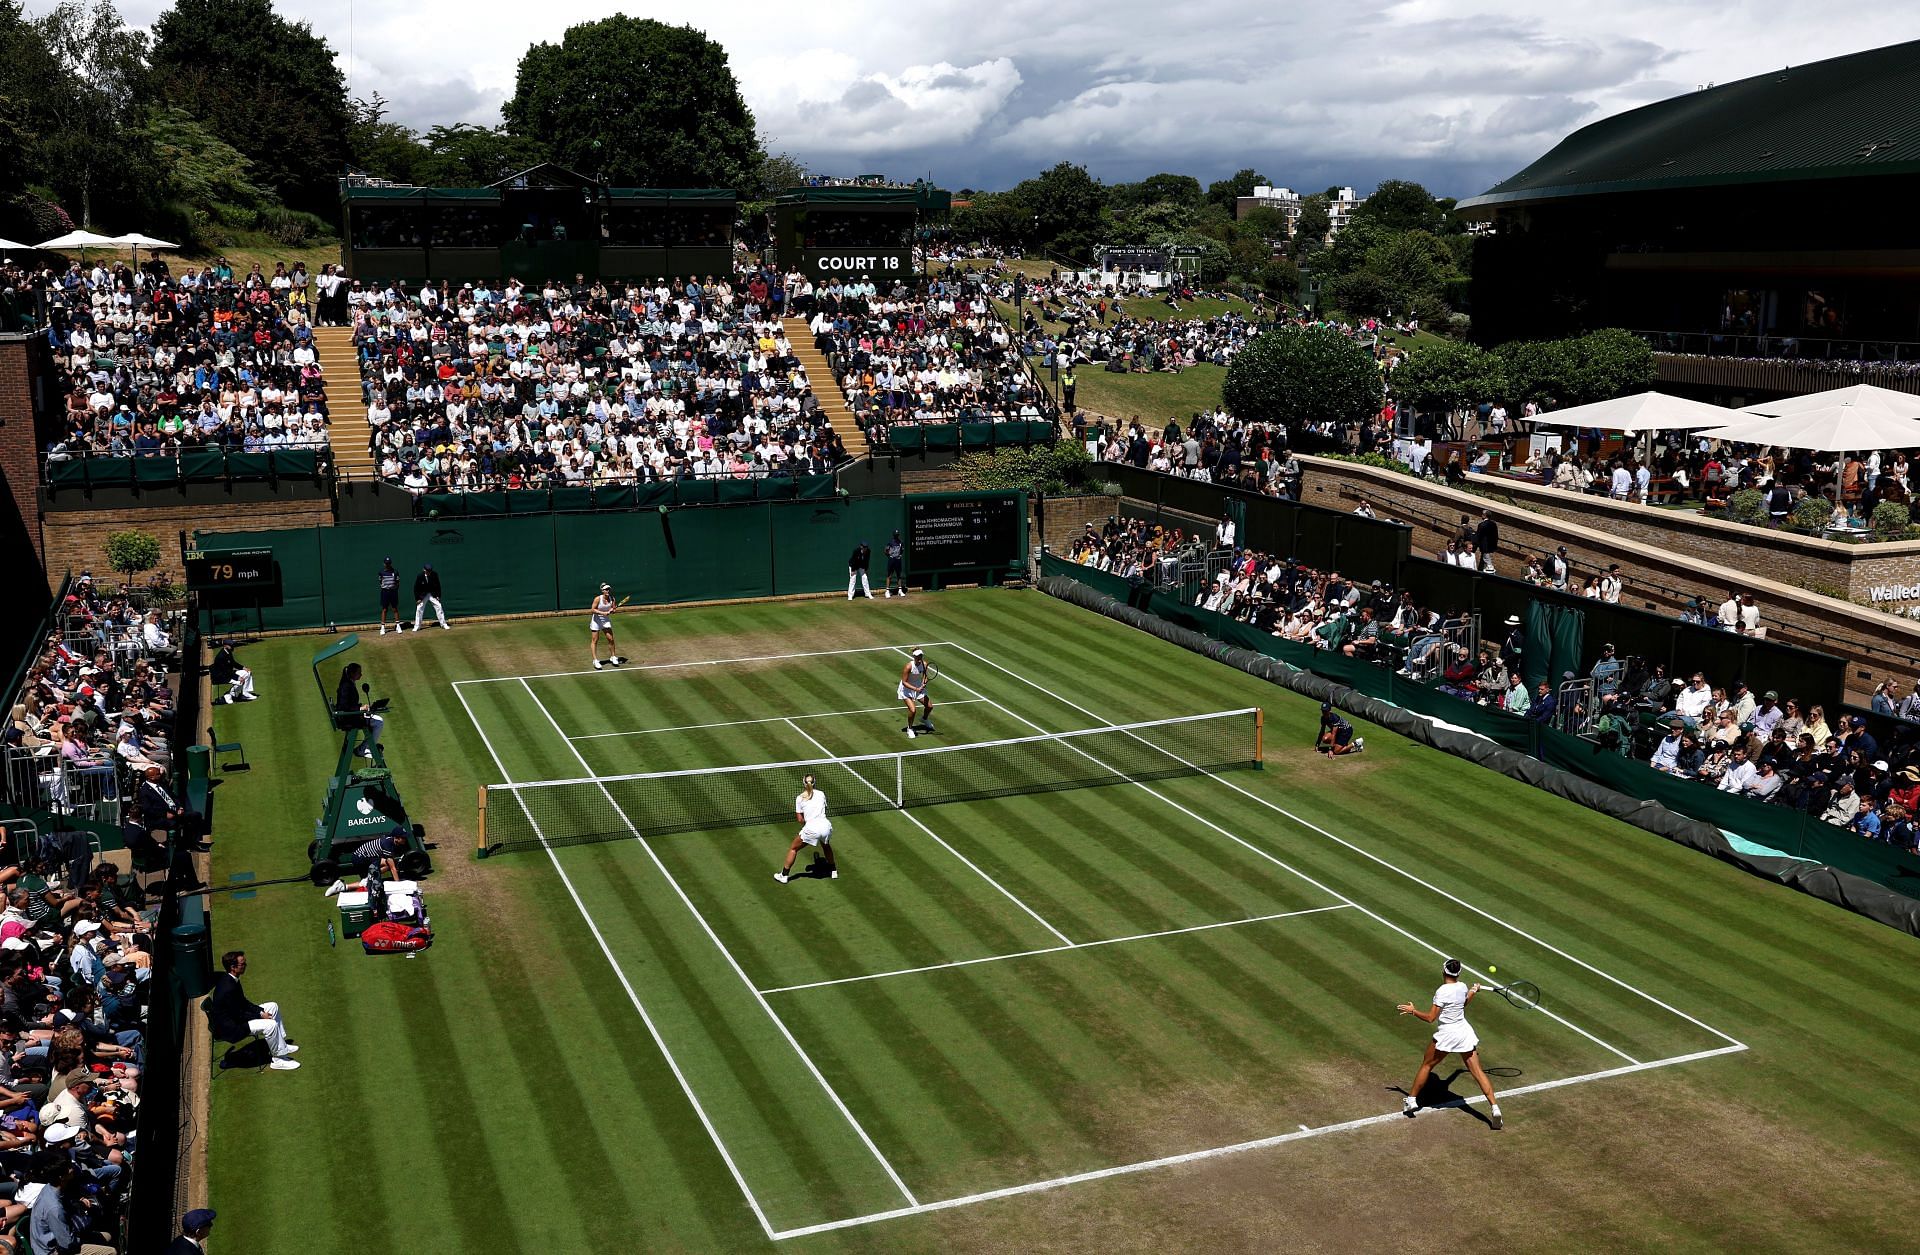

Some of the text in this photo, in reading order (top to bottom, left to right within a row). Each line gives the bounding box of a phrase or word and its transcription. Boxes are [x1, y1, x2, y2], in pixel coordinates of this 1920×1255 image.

[818, 256, 899, 270] COURT 18
[186, 551, 205, 560] IBM
[210, 564, 259, 580] 79 mph
[1870, 582, 1920, 602] Walled
[348, 815, 386, 827] BARCLAYS
[391, 940, 417, 949] YONEX
